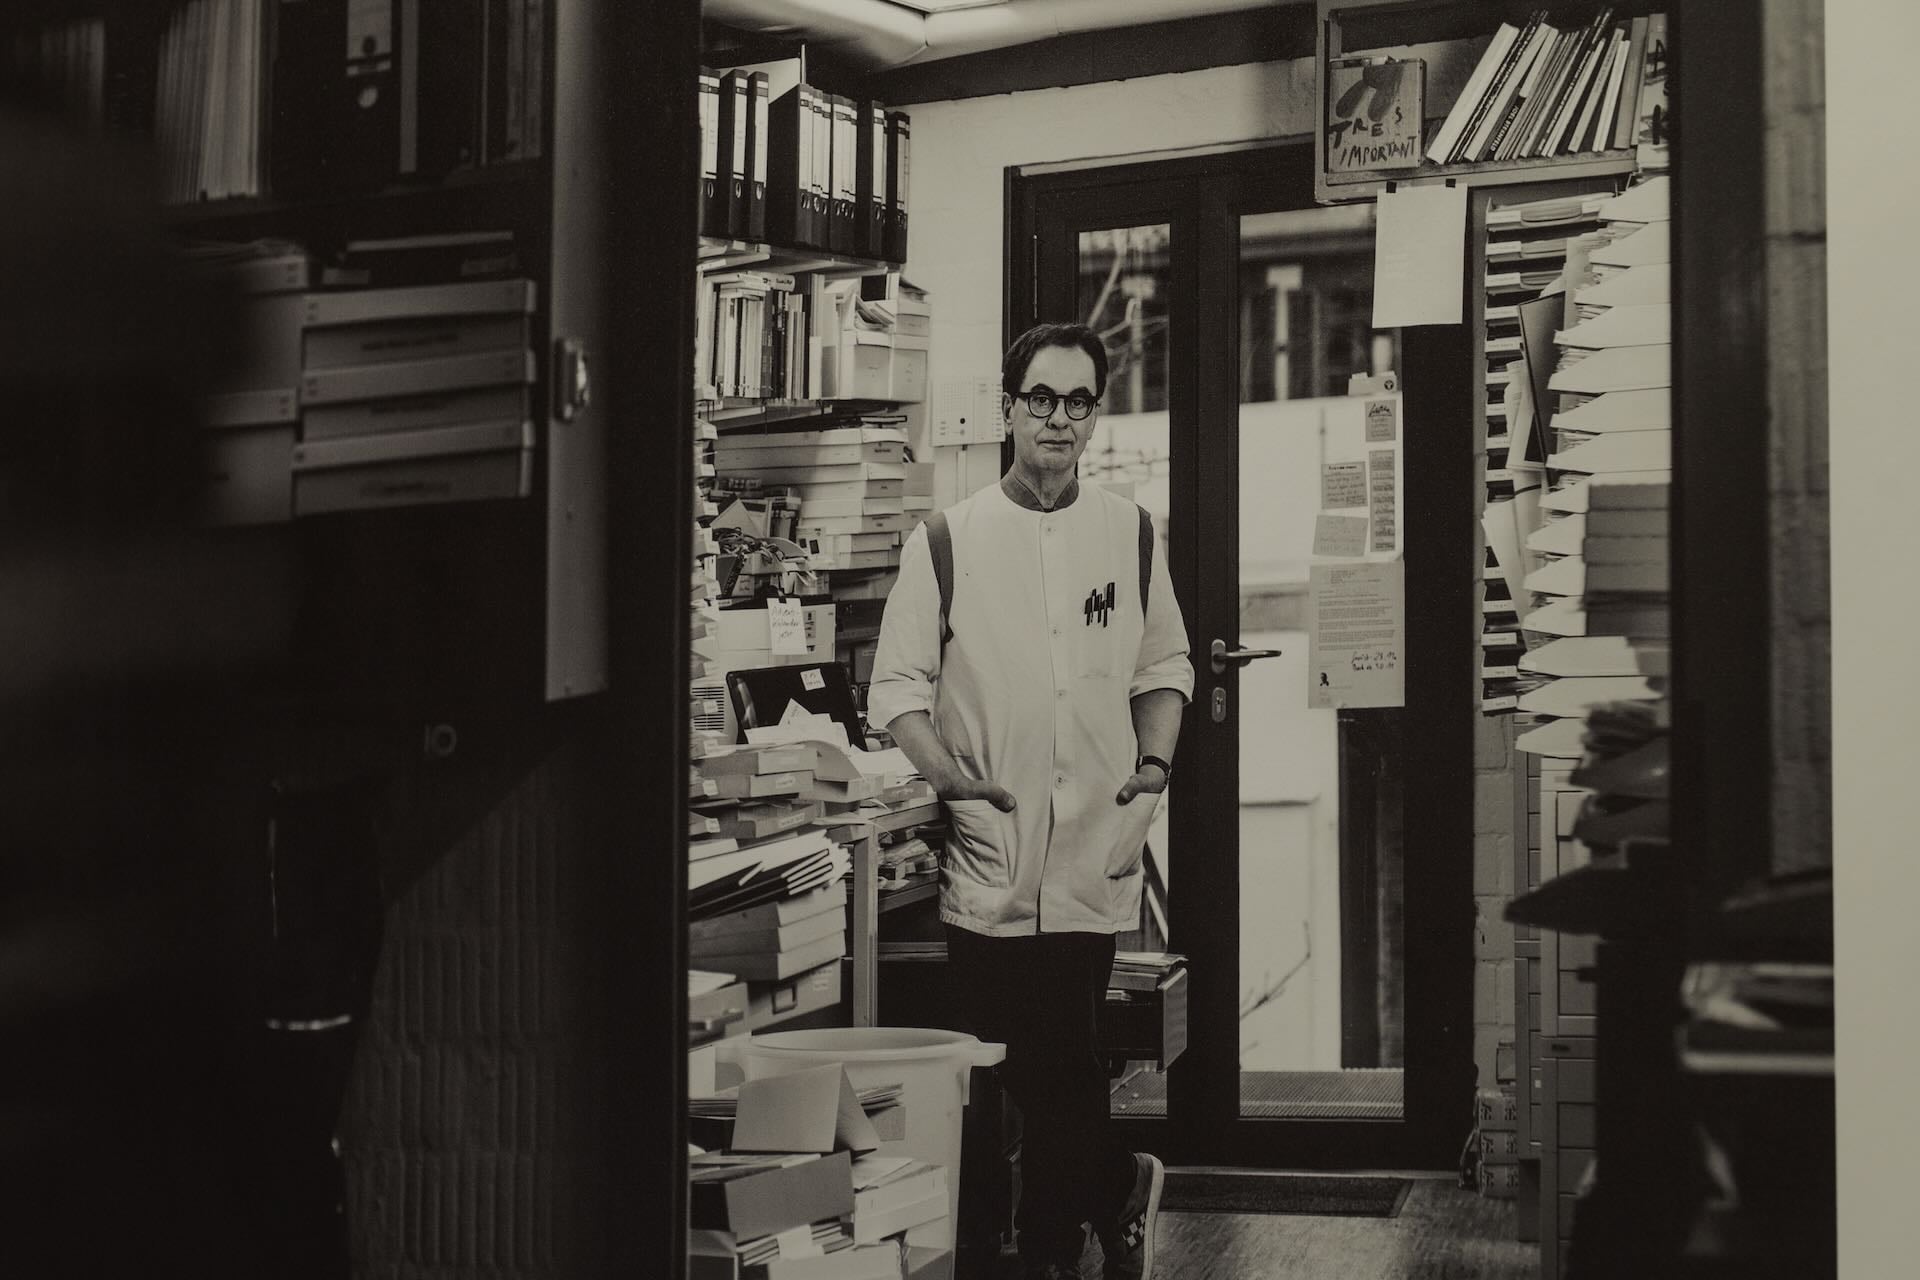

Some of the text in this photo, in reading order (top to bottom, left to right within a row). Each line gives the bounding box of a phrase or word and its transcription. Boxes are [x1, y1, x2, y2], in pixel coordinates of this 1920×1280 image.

[1489, 105, 1520, 152] JOEL STERNFELD
[1339, 136, 1417, 168] IMPORTANT
